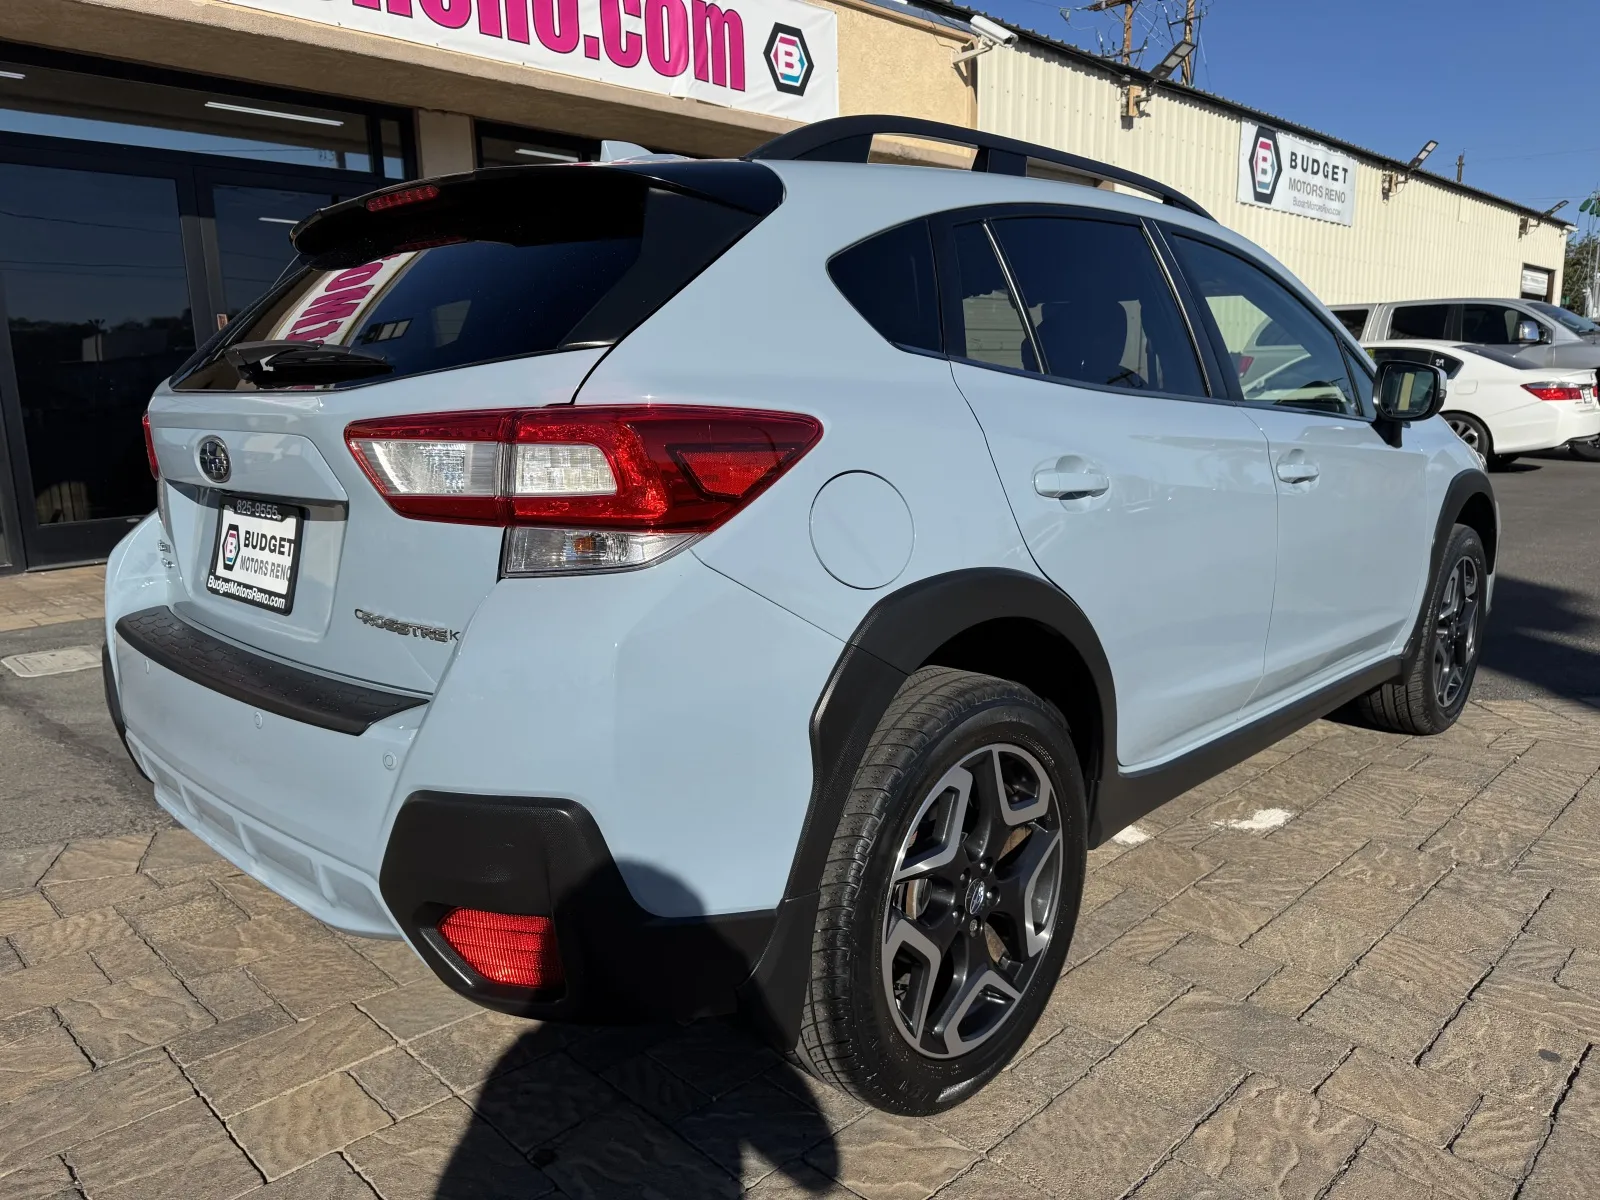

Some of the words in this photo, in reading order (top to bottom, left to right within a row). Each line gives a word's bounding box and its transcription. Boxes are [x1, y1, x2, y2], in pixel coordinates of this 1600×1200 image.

[1289, 151, 1348, 184] BUDGET
[1288, 177, 1323, 198] MOTORS
[1324, 187, 1346, 204] RENO
[236, 500, 279, 519] 825-9555
[243, 530, 295, 557] BUDGET
[240, 555, 269, 577] MOTORS
[207, 575, 286, 609] BudgetMotorsReno.com
[354, 608, 461, 643] CROSSTREK
